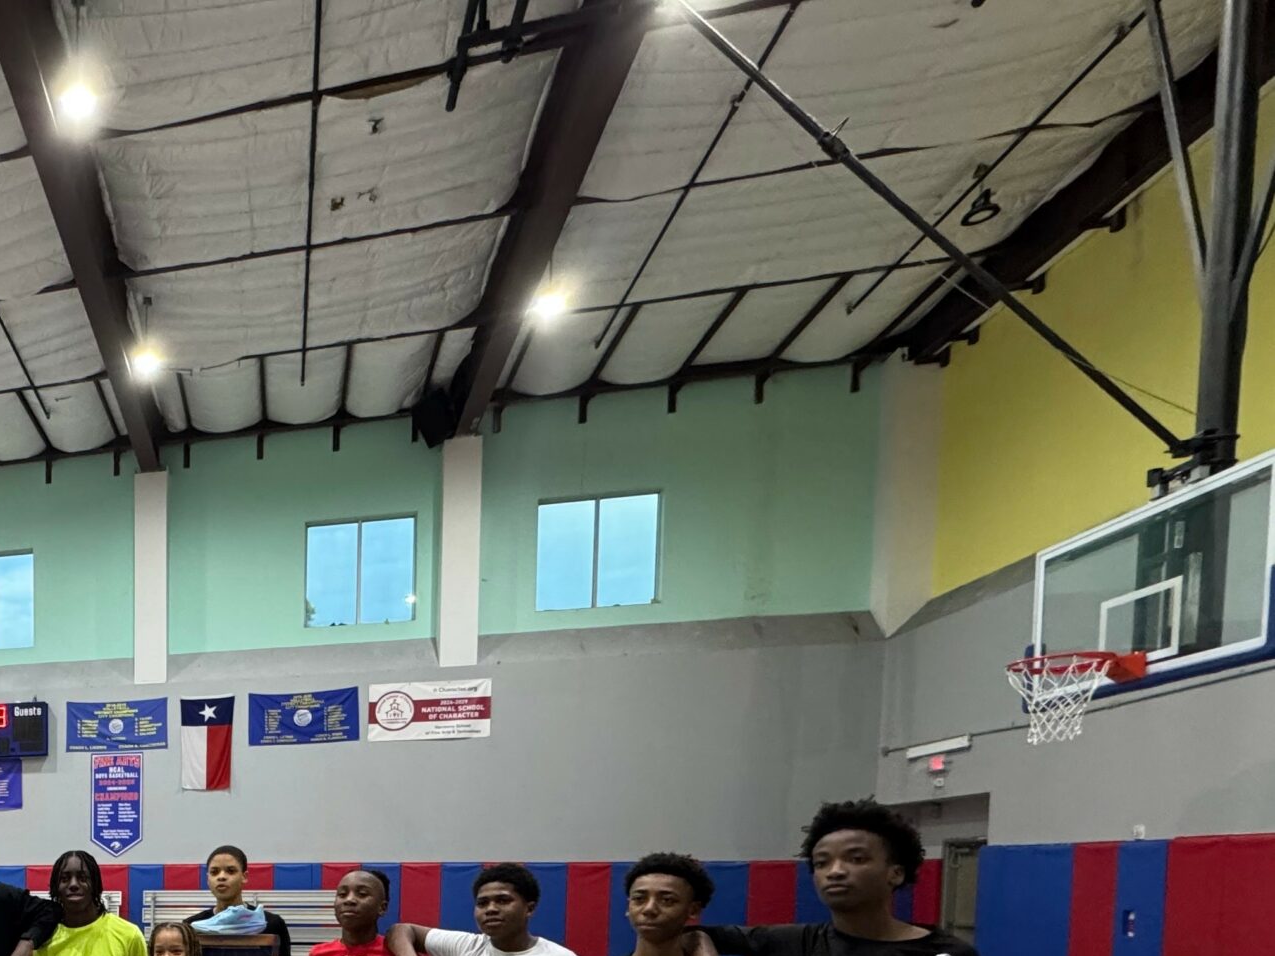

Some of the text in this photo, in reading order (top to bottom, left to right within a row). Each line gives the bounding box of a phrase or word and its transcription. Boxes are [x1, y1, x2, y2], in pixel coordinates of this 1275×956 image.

[14, 706, 42, 717] Guests
[421, 705, 456, 713] NATIONAL
[439, 711, 479, 719] CHARACTER
